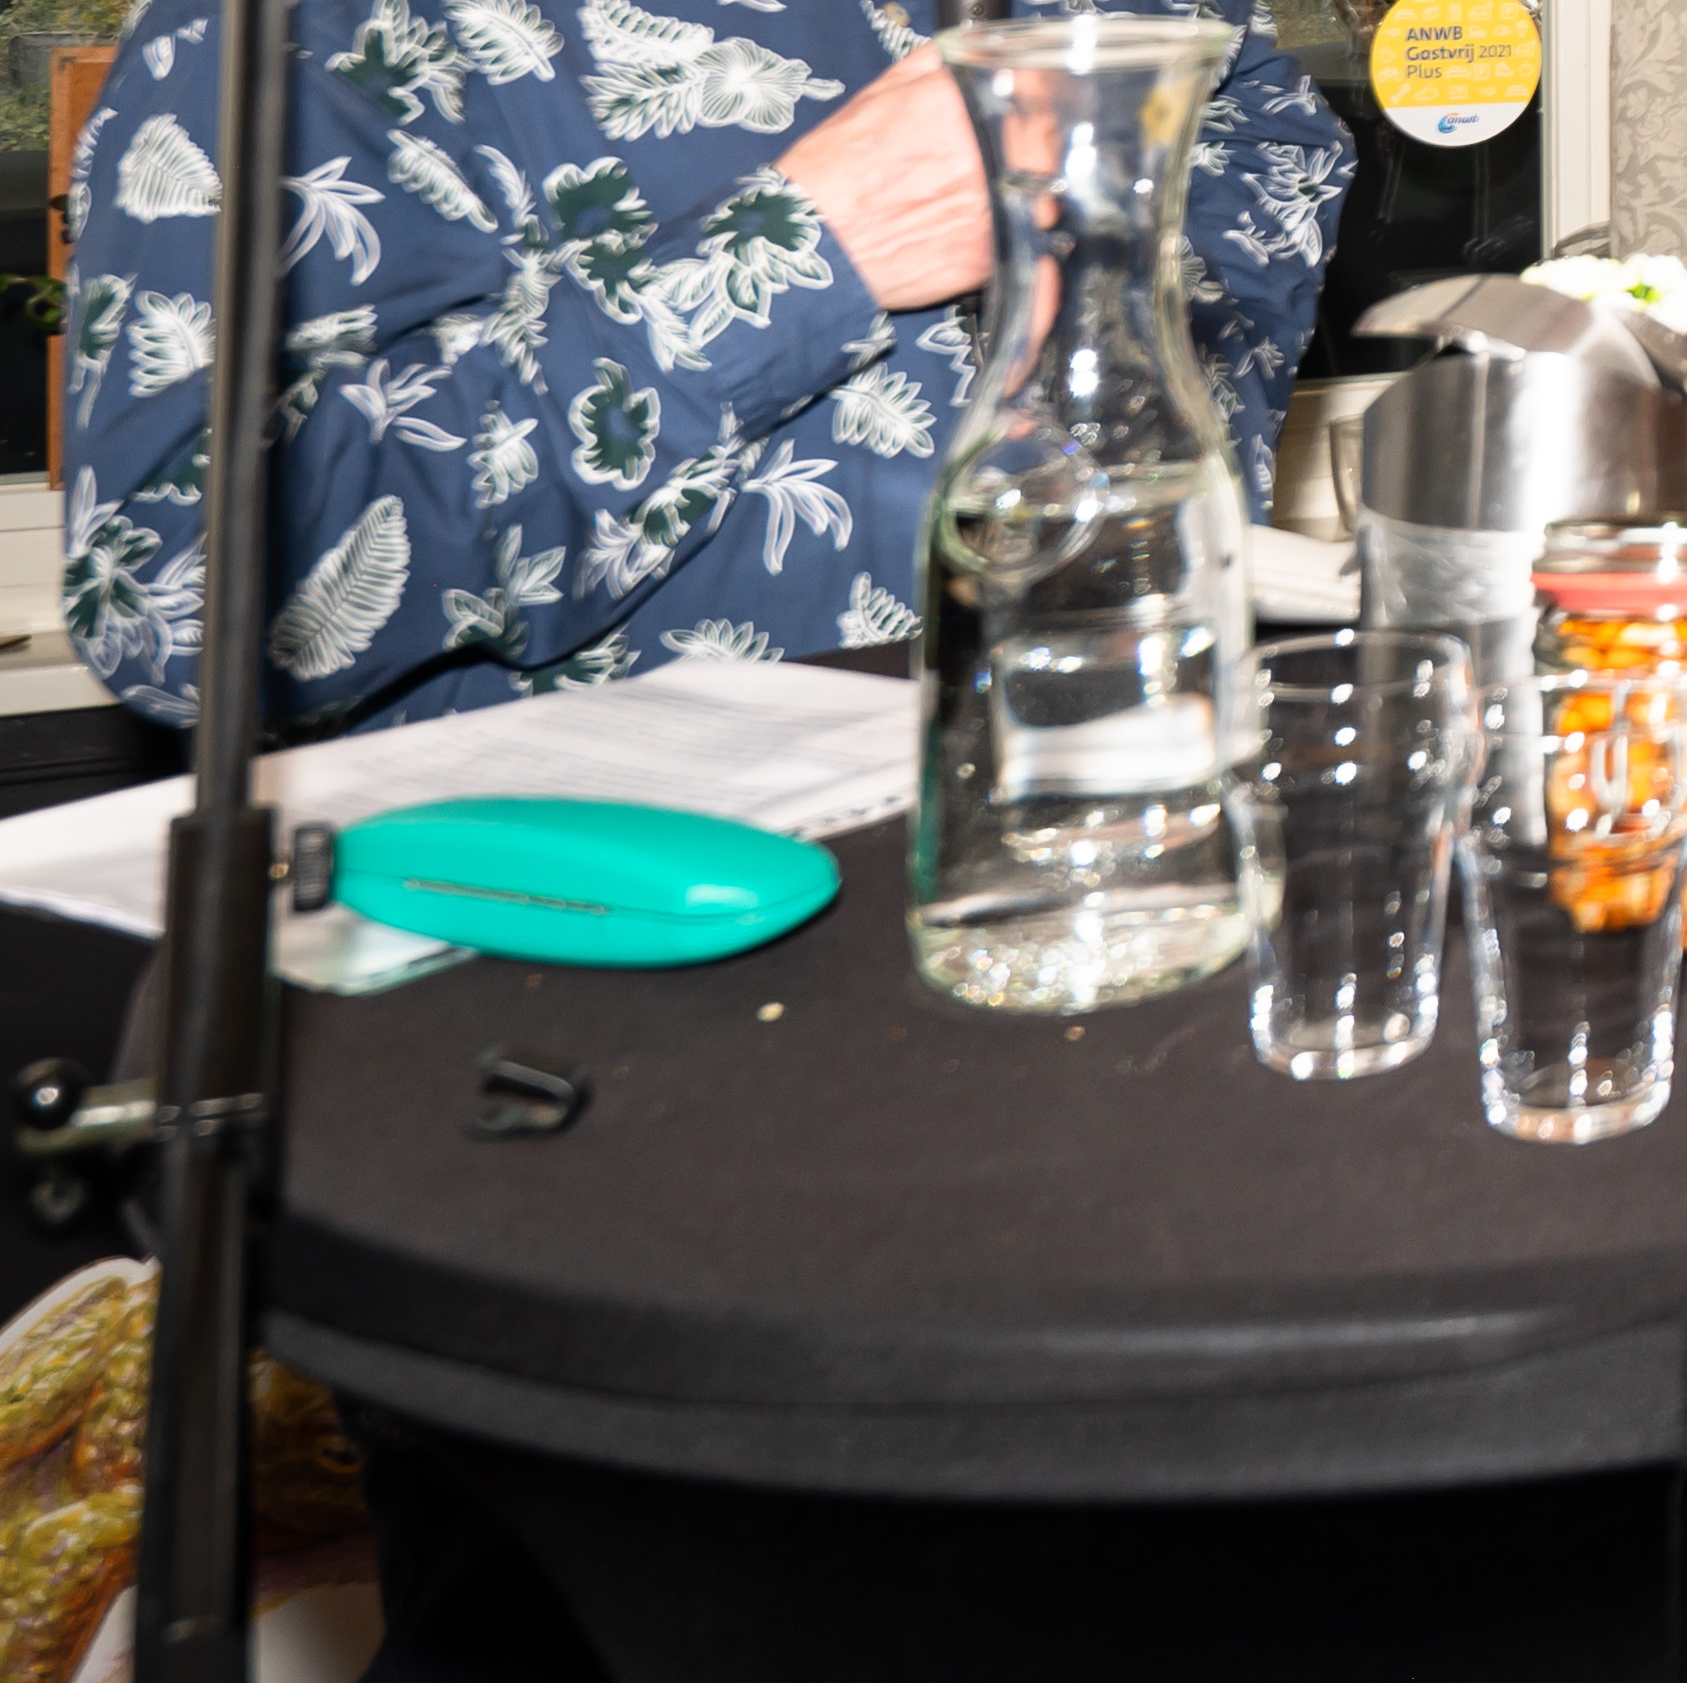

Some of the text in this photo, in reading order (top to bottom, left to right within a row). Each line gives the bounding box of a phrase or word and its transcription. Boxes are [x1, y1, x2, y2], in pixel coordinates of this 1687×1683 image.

[1405, 25, 1464, 42] ANWB
[1405, 43, 1512, 64] Gastvrij 2021
[1406, 63, 1443, 79] Plus
